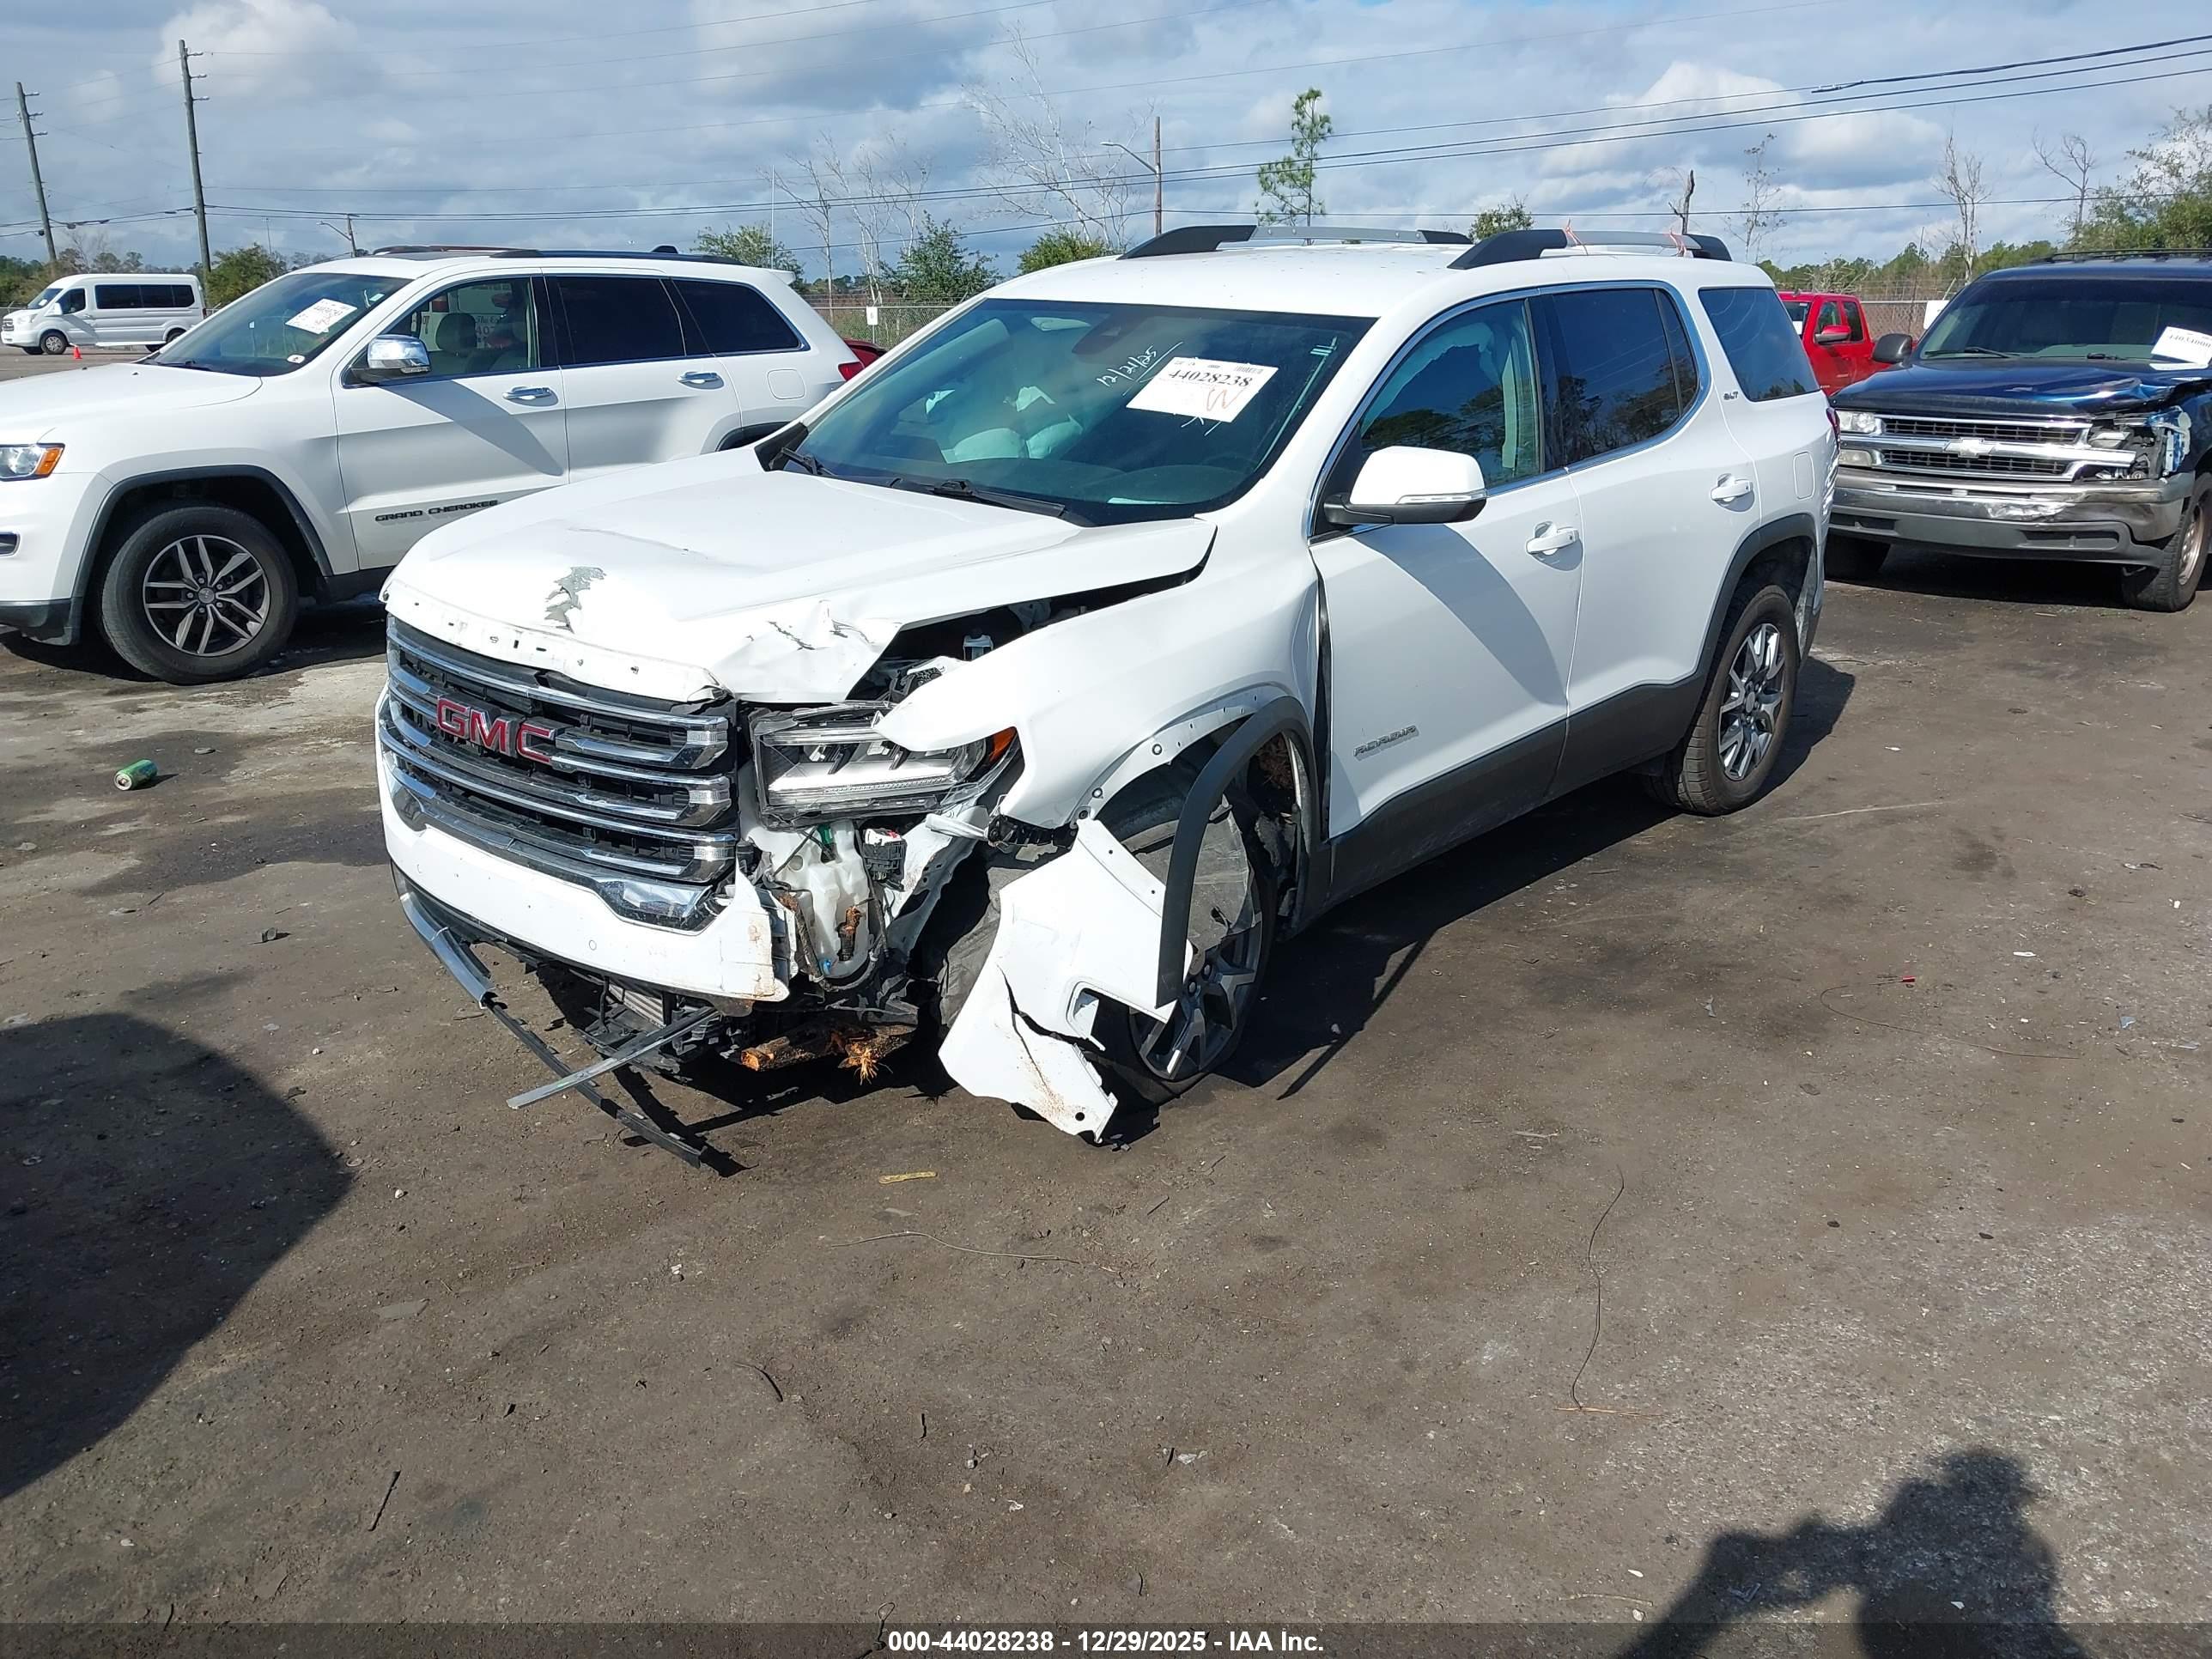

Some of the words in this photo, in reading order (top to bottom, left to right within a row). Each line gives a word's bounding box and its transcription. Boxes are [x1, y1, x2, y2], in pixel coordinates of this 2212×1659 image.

[1168, 369, 1253, 387] 44028238
[374, 509, 423, 522] GRAND
[428, 500, 499, 514] CHEROKEE
[436, 696, 556, 765] GMC
